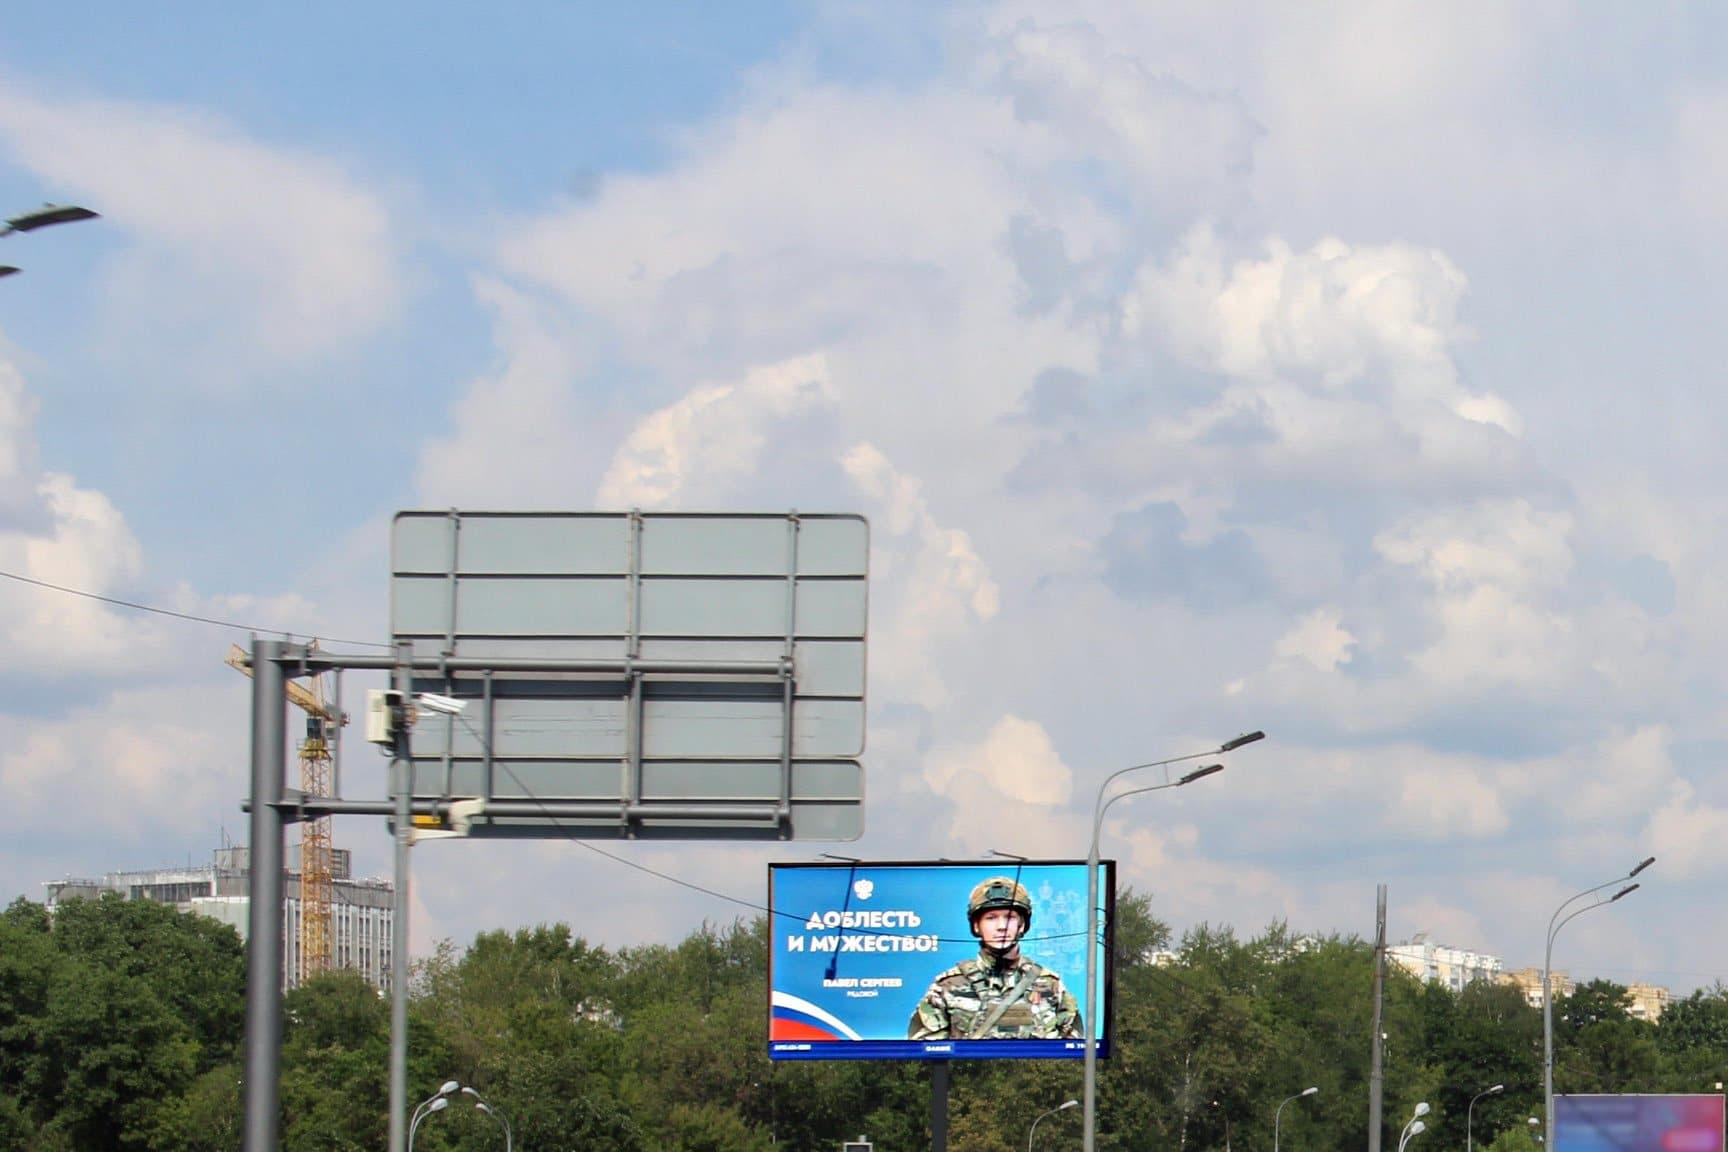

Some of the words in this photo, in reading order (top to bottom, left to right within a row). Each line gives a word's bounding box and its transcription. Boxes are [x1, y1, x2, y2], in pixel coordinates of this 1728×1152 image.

[806, 911, 921, 930] ДОБЛЕСТЬ
[788, 935, 804, 952] И
[810, 935, 939, 952] МУЖЕСТВО!
